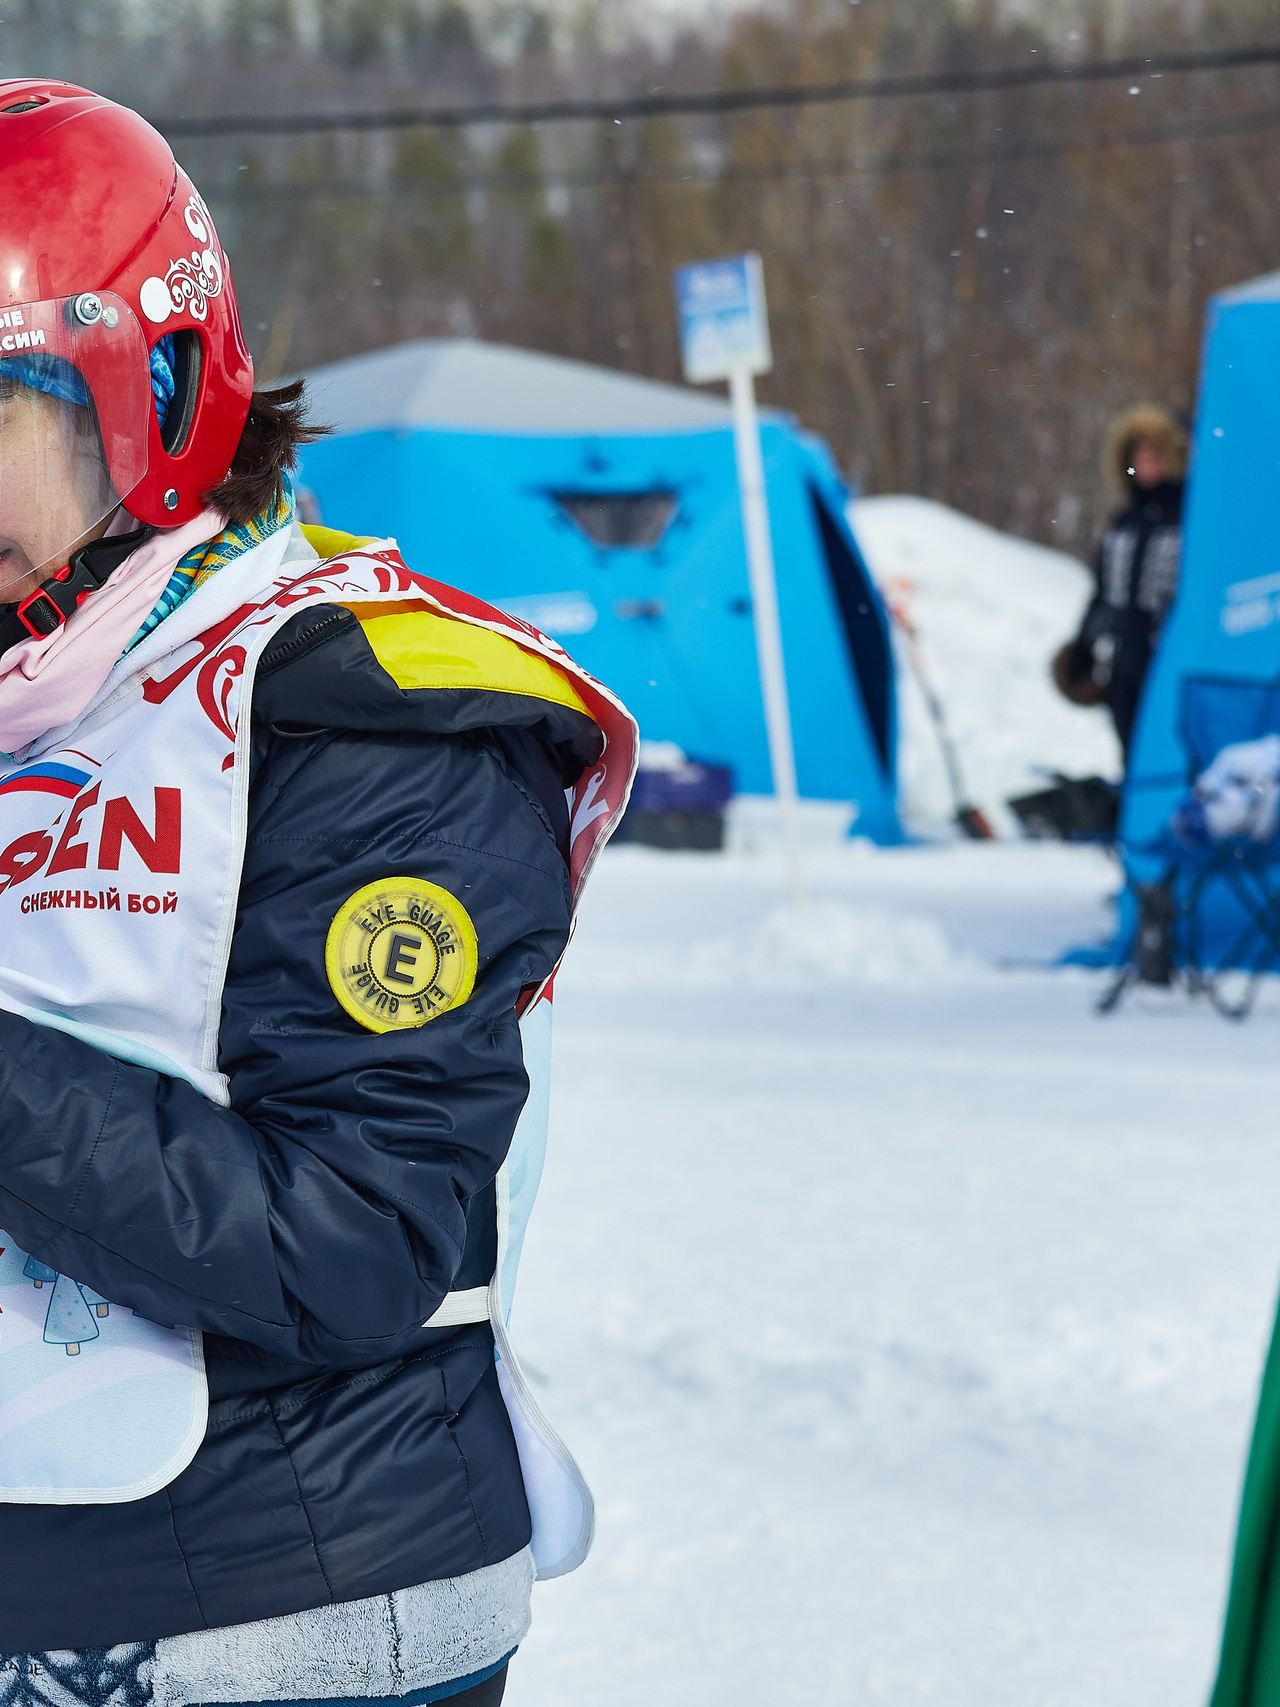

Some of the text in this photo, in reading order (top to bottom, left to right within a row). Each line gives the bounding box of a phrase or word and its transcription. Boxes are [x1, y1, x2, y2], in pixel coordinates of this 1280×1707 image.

[20, 887, 178, 914] СНЕЖНЫЙ БОЙ
[360, 904, 456, 957] EYE GUAGE
[386, 934, 422, 985] E
[351, 962, 446, 1015] EYE GUAGE
